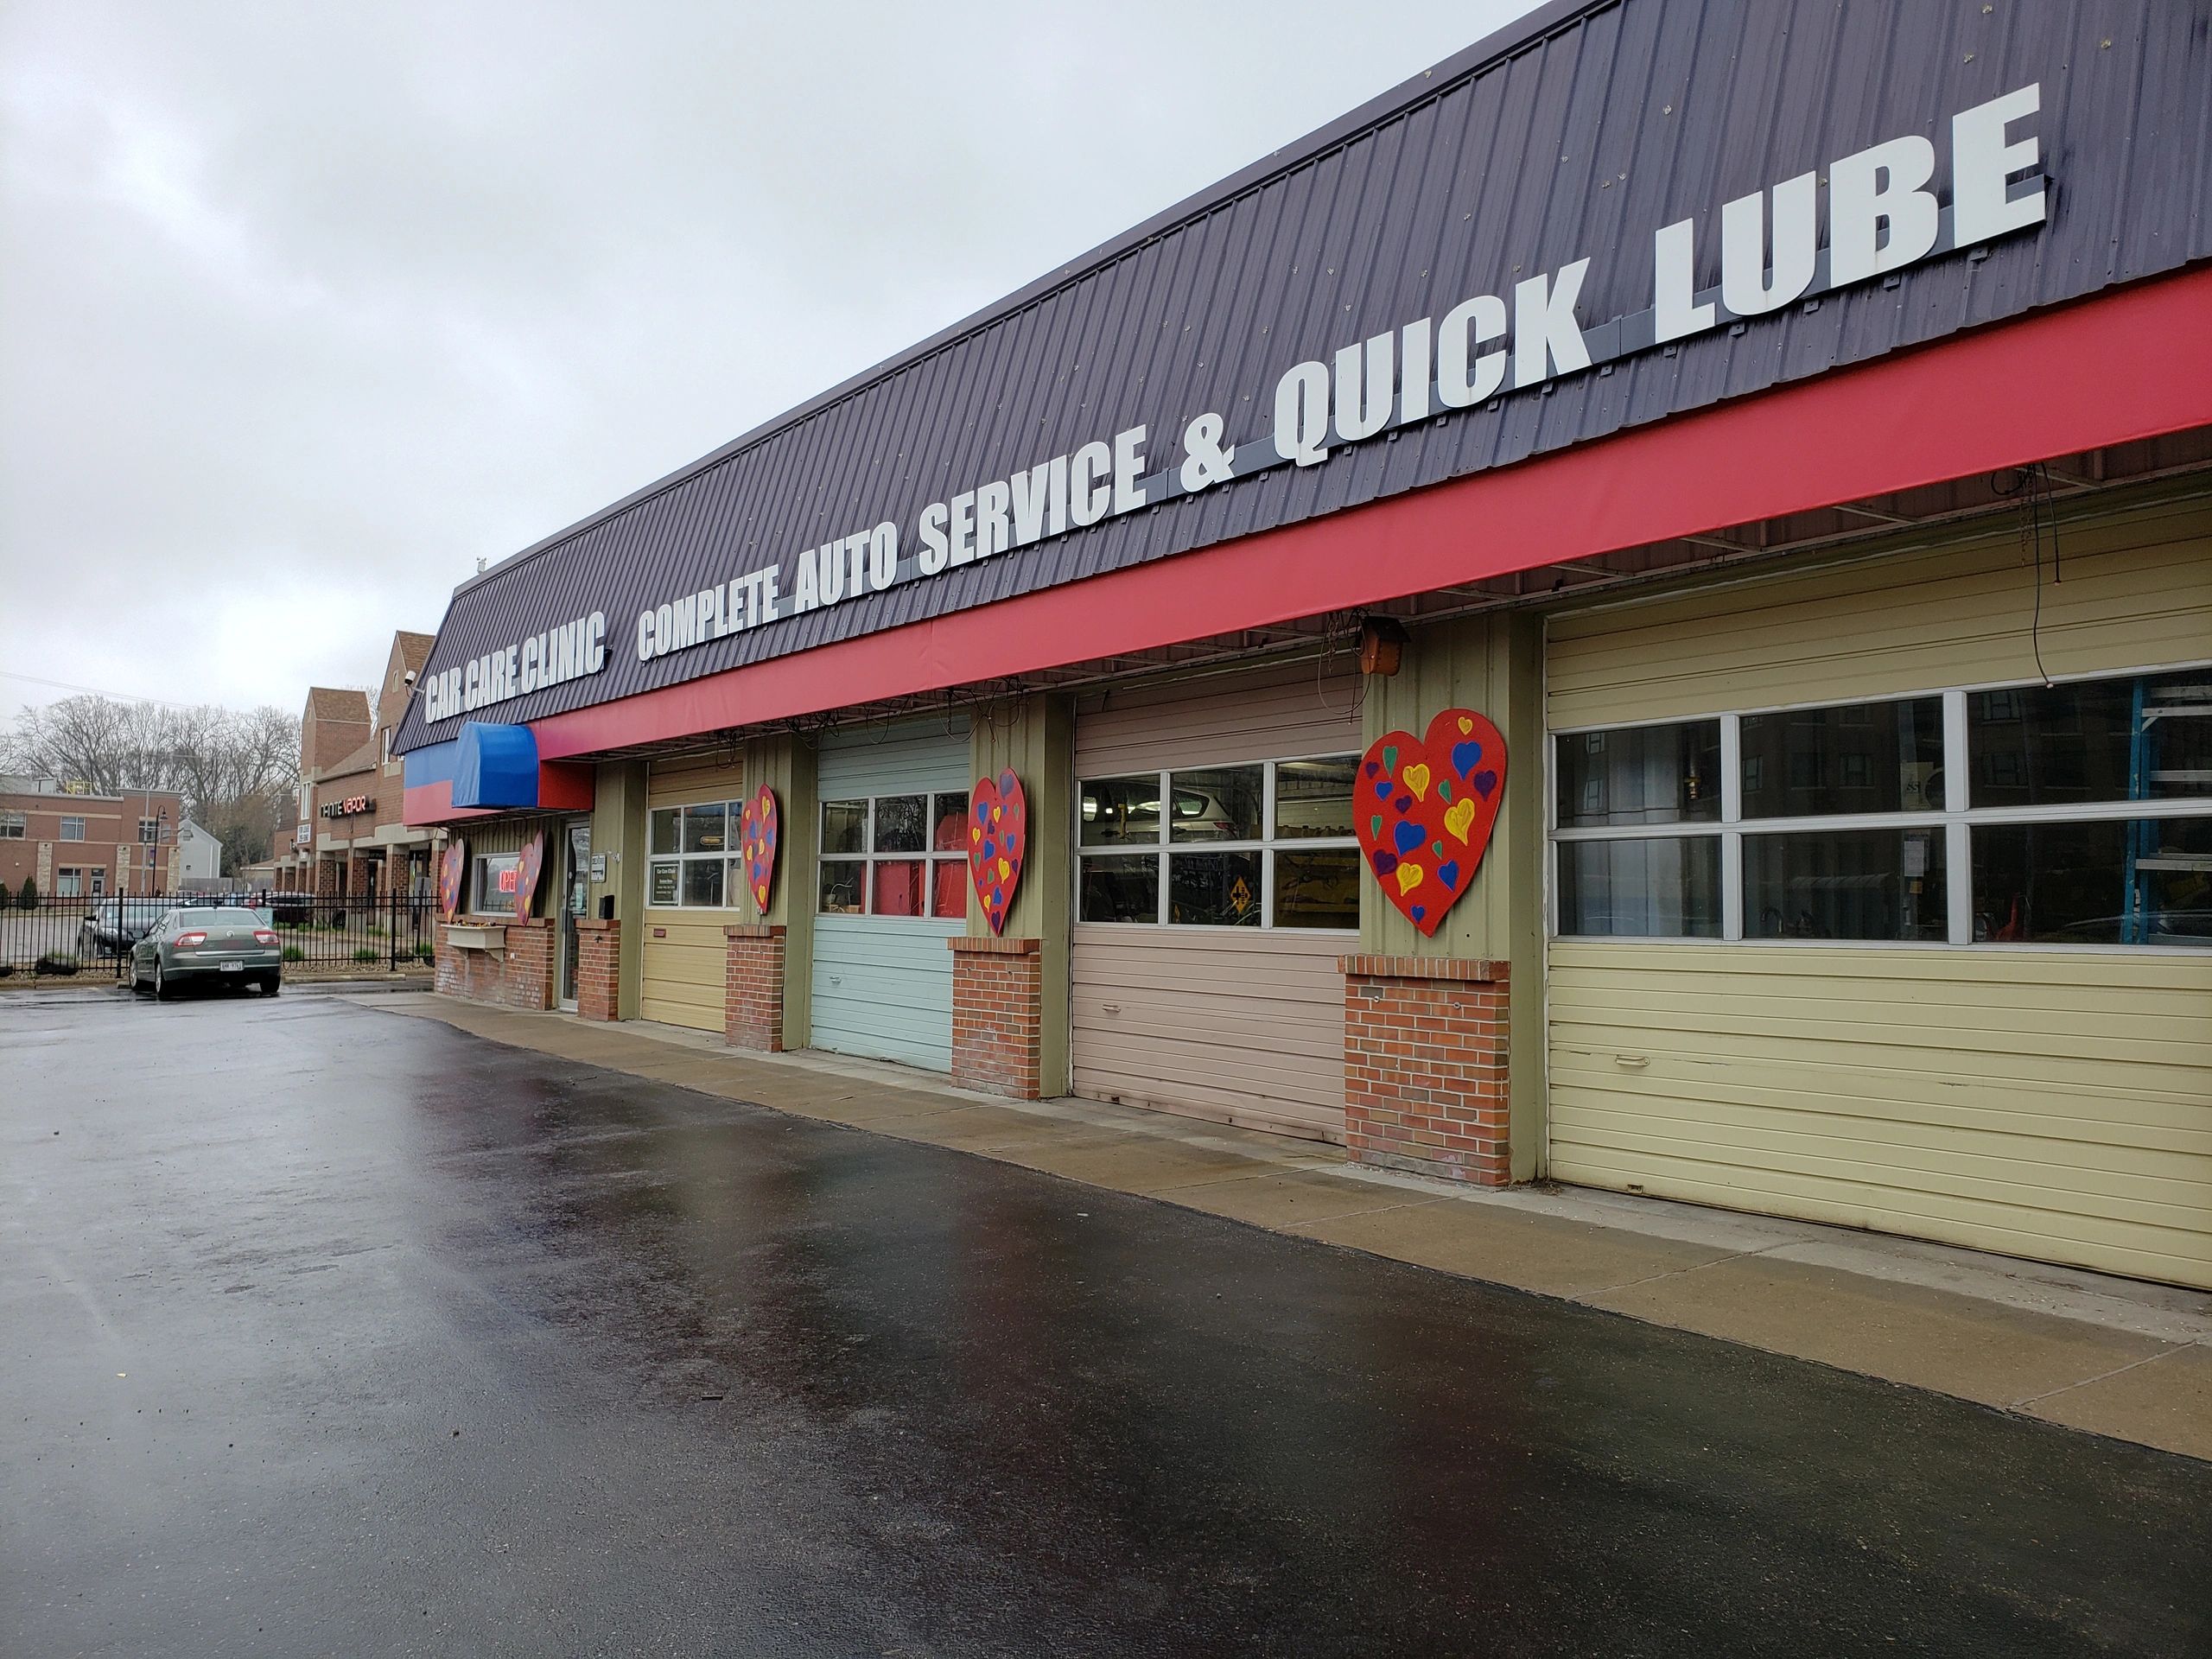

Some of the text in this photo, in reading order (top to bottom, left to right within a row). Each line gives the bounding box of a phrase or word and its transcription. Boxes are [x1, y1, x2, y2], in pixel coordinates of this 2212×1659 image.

[425, 82, 2046, 724] CAR CARE CLINIC COMPLETE AUTO SERVICE & QUICK LUBE
[343, 795, 366, 814] VAPOR
[499, 870, 517, 893] OPE
